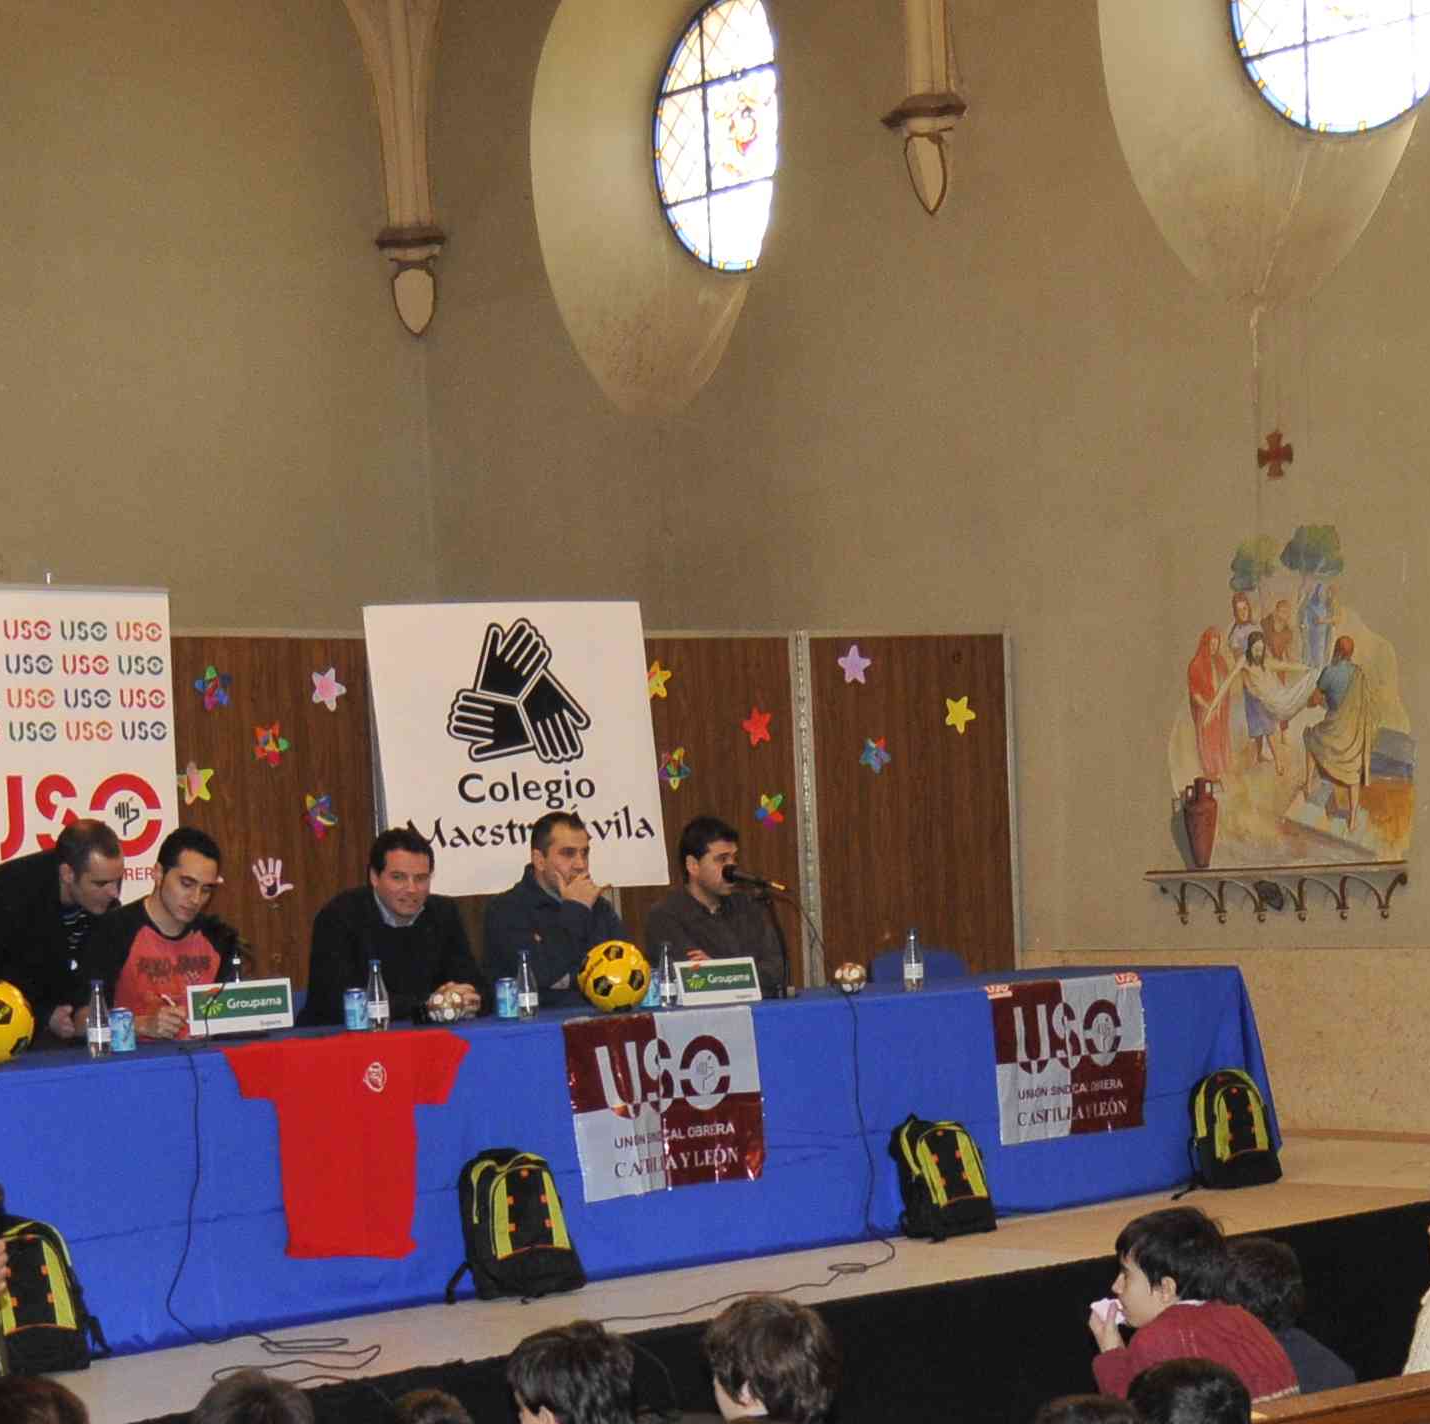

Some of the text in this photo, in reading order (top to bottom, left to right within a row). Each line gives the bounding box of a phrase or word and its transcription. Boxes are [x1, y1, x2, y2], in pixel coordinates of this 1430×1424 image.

[3, 619, 51, 640] USO
[61, 621, 107, 641] USO
[116, 622, 162, 642] USO
[5, 654, 53, 674] USO
[63, 655, 109, 675] USO
[118, 655, 163, 675] USO
[7, 688, 55, 708] USO
[64, 689, 111, 708] USO
[120, 688, 165, 708] USO
[9, 721, 57, 741] USO
[66, 721, 113, 741] USO
[121, 721, 167, 741] USO
[458, 770, 596, 809] Colegio
[407, 817, 533, 848] Maestr
[227, 996, 282, 1009] Groupama
[1013, 999, 1121, 1074] USO
[595, 1034, 731, 1119] USO
